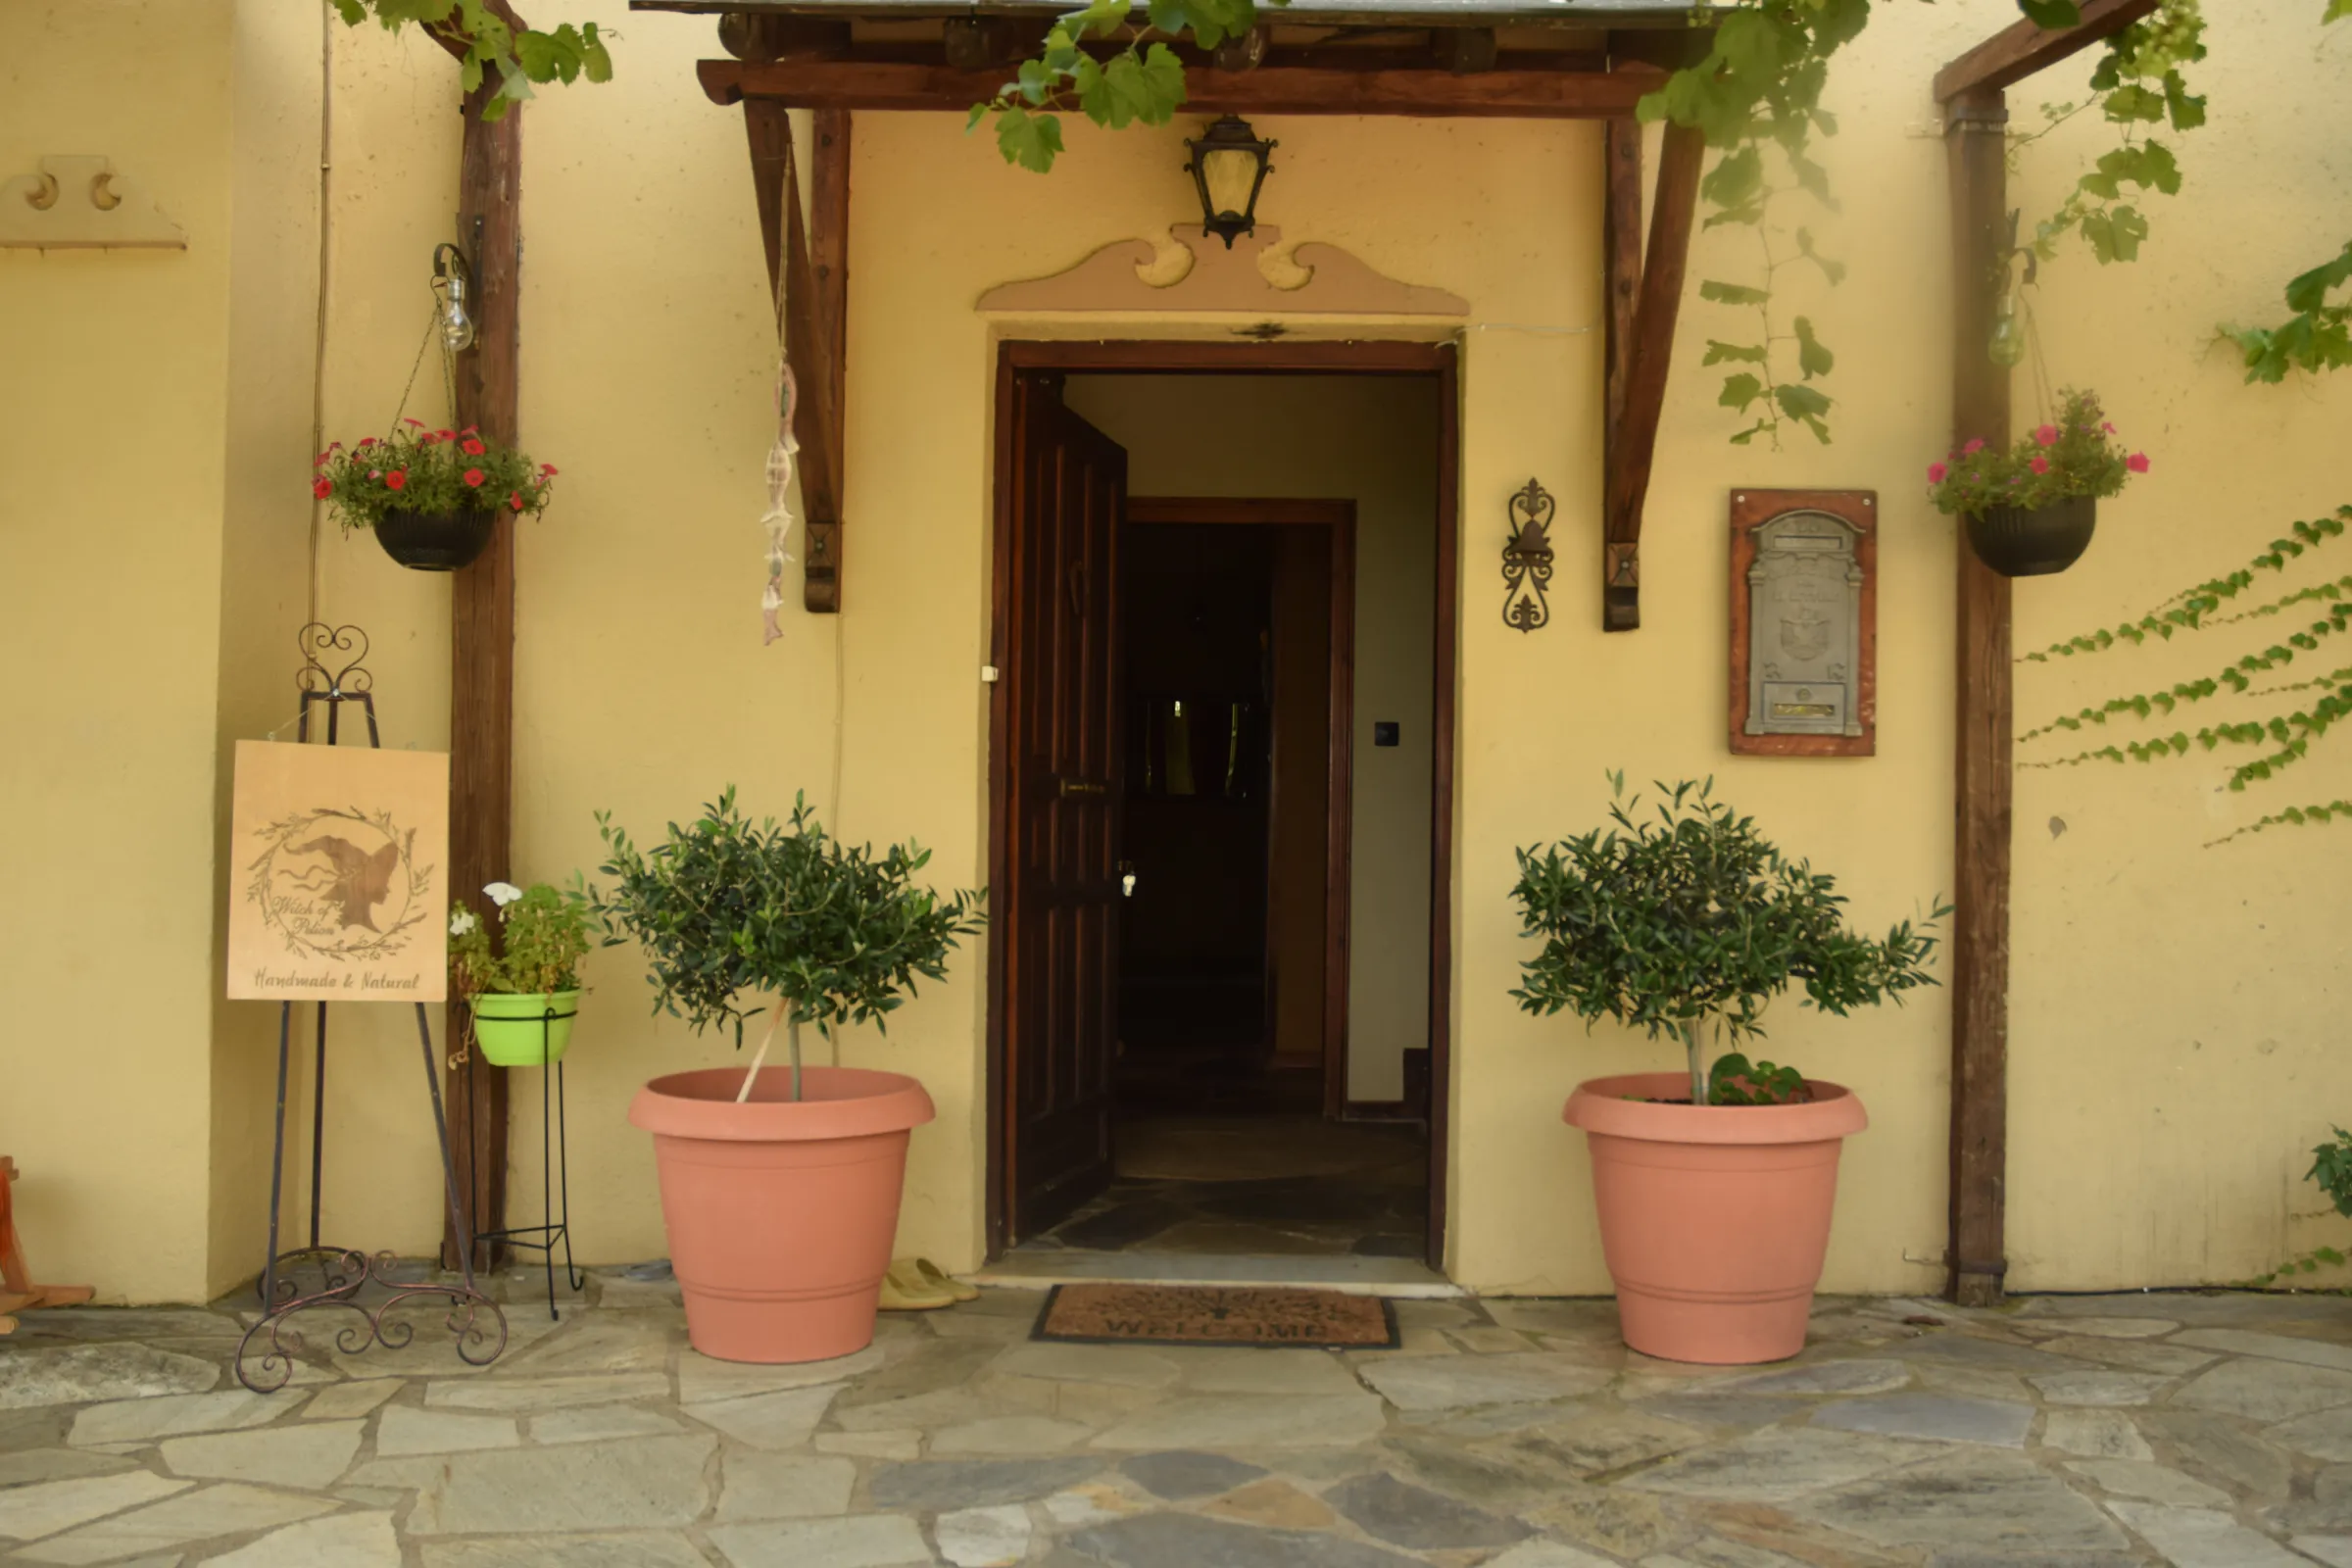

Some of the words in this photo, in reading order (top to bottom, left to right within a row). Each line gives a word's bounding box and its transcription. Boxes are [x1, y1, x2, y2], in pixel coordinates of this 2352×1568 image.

[273, 896, 314, 914] Witch
[318, 903, 334, 922] of
[254, 965, 337, 990] Handmade
[343, 972, 354, 989] &
[361, 971, 420, 991] Natural
[1105, 1320, 1327, 1339] WELCOME
